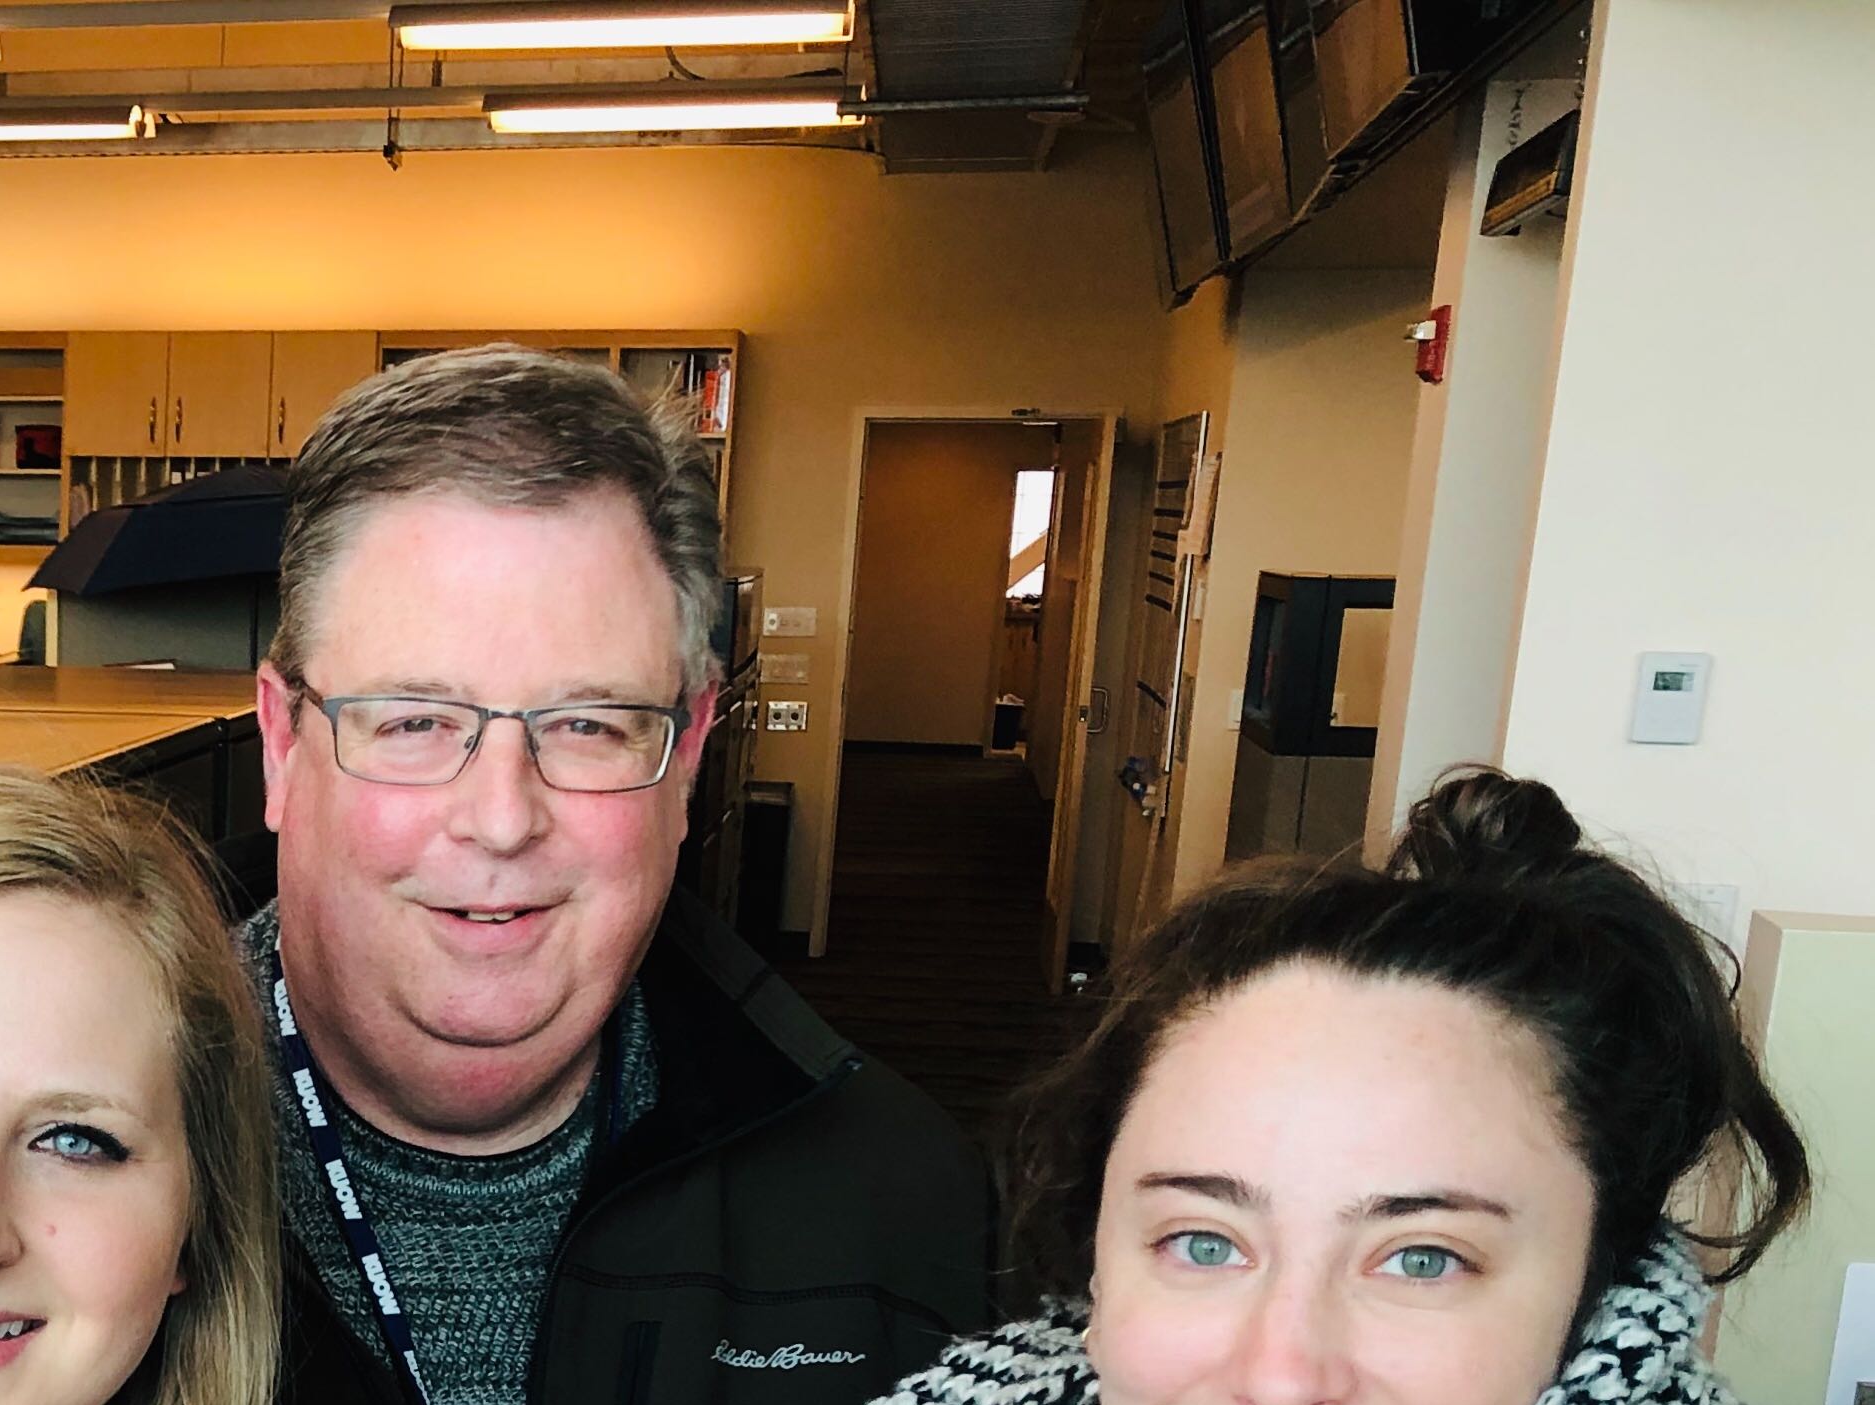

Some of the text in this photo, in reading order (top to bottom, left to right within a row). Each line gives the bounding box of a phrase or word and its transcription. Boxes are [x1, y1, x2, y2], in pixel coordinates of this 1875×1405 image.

[292, 1067, 328, 1128] KUOW
[325, 1159, 363, 1219] KUOW
[361, 1253, 401, 1315] KUOW
[769, 1343, 866, 1370] Bauer
